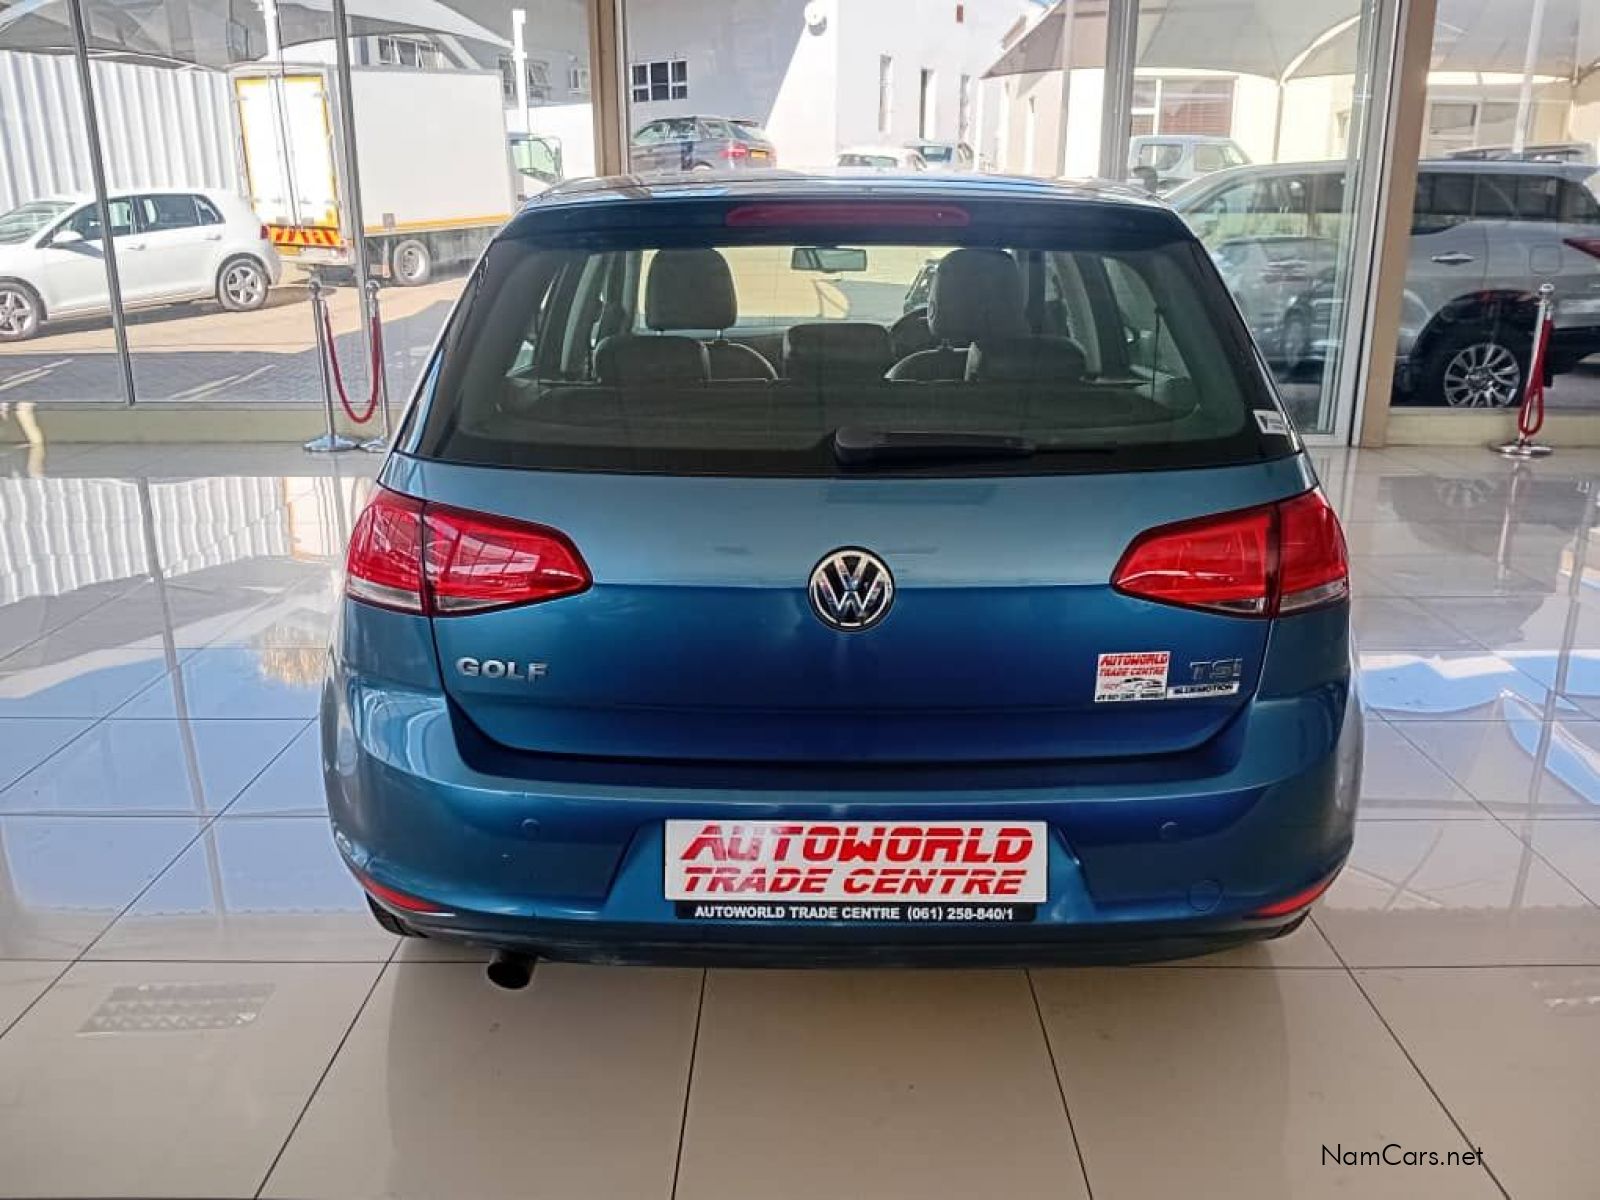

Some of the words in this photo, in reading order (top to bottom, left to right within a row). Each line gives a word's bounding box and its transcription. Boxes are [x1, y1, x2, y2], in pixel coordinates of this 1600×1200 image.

[456, 656, 549, 681] GOLF
[1101, 653, 1168, 666] AUTOWORLD
[681, 824, 1034, 863] AUTOWORLD
[684, 867, 833, 893] TRADE
[843, 869, 1027, 895] CENTRE
[695, 905, 786, 919] AUTOWORLD
[789, 906, 838, 919] TRADE
[842, 906, 900, 920] CENTRE
[907, 905, 943, 921] (061)
